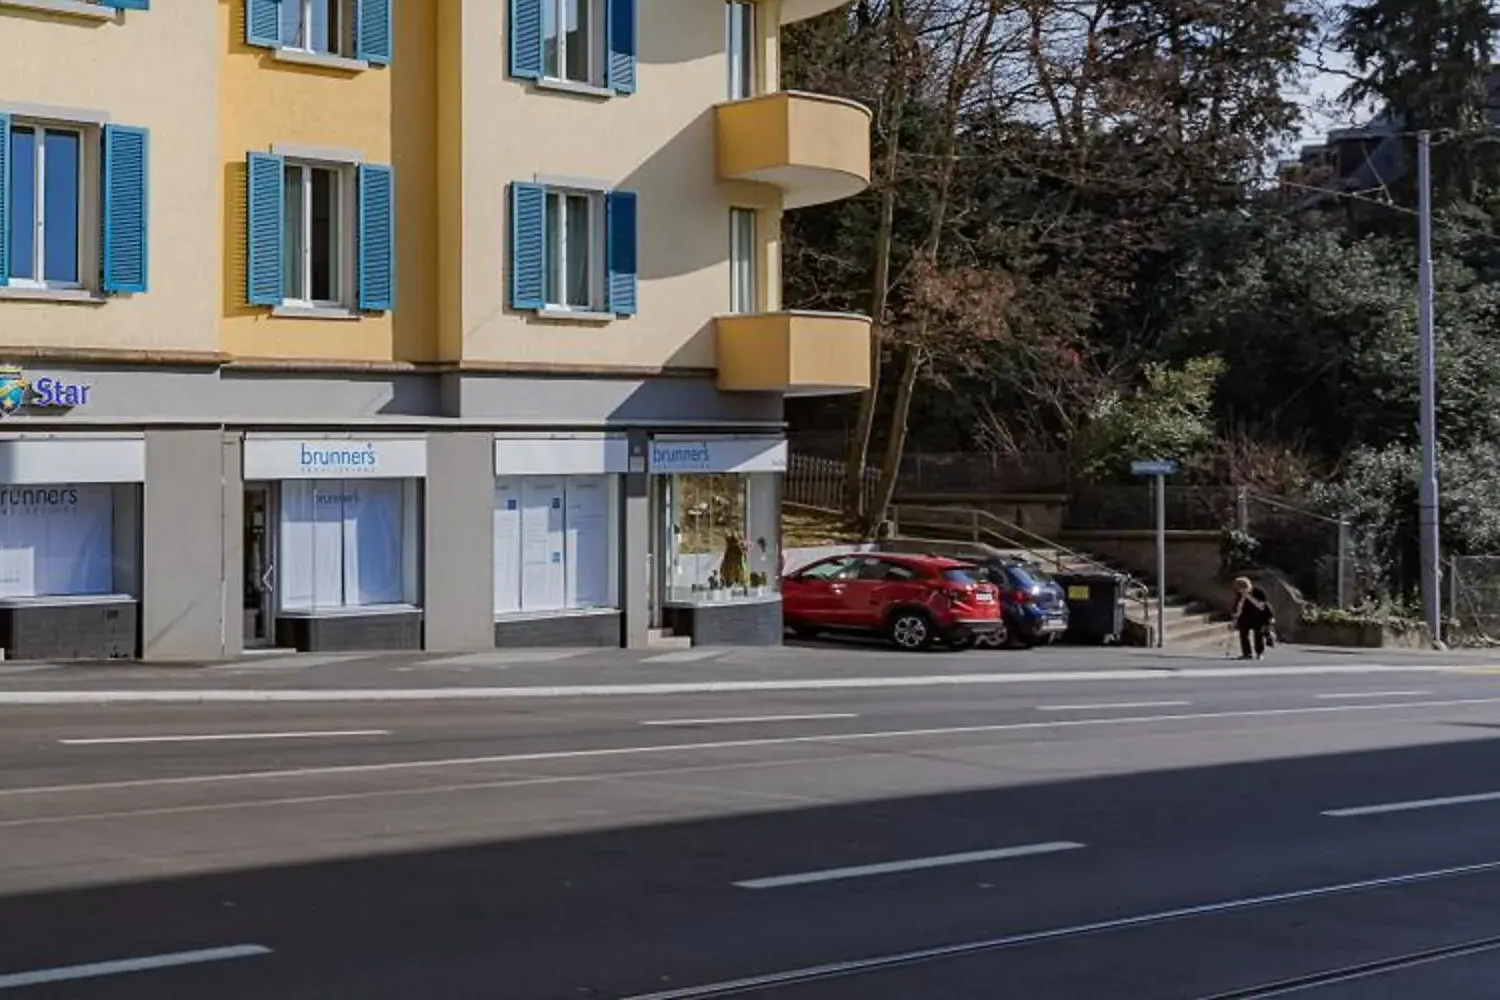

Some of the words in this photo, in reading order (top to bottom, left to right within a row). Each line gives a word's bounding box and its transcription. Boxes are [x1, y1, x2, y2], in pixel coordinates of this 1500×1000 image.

[34, 377, 91, 406] Star
[301, 442, 375, 466] brunner's
[653, 440, 710, 463] brunner's
